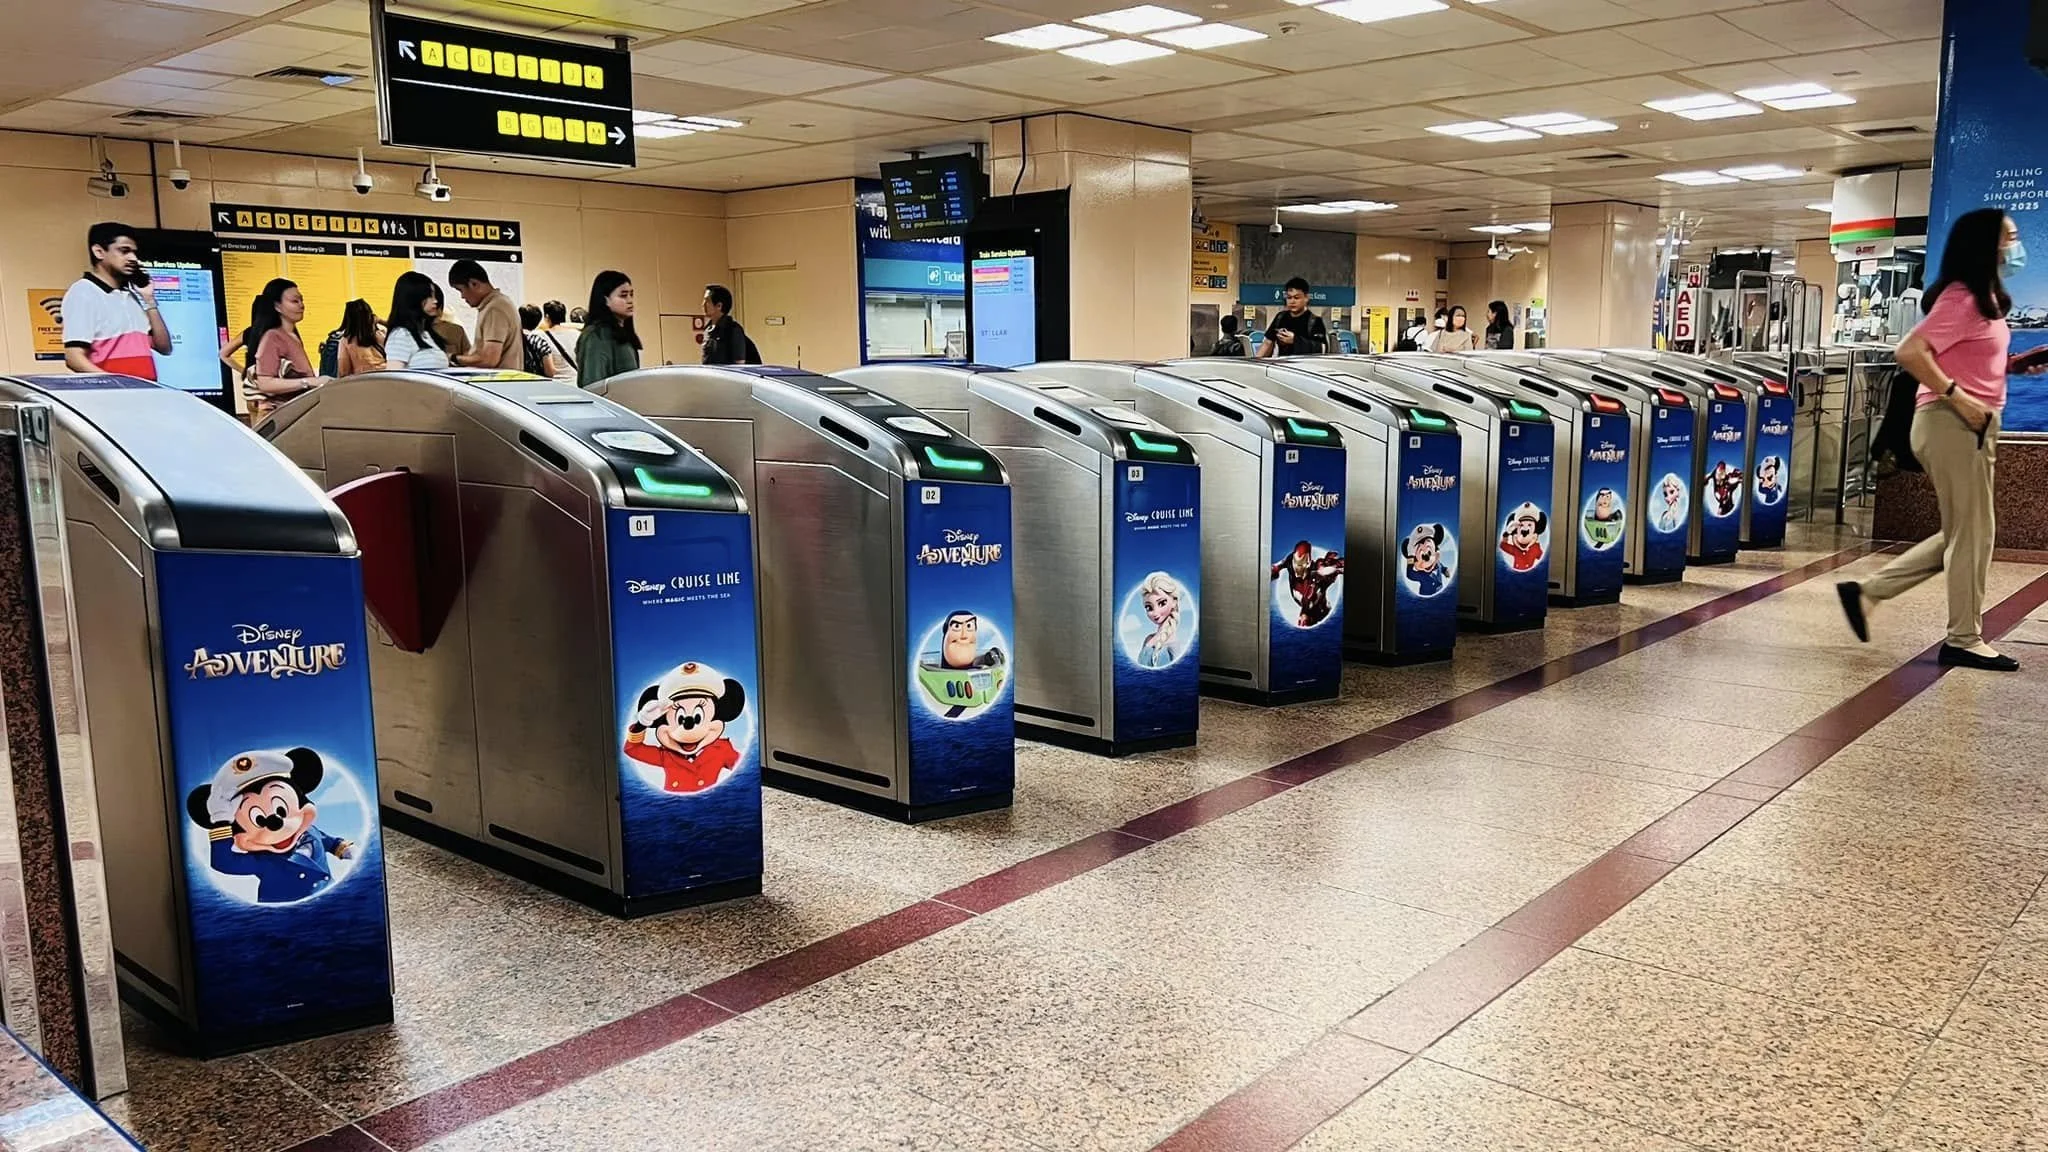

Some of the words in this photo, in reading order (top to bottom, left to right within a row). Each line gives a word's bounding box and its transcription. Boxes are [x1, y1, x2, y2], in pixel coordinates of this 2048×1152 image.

[1995, 167, 2043, 179] SAILING
[2001, 179, 2034, 189] FROM
[1983, 190, 2048, 202] SINGAPORE
[2010, 201, 2039, 211] 2025
[1676, 290, 1692, 337] AED
[1131, 469, 1140, 478] 03
[925, 490, 936, 500] 02
[1151, 508, 1176, 520] CRUISE
[1178, 507, 1194, 518] LINE
[635, 519, 649, 532] 01
[916, 543, 1002, 567] ADVENTURE
[670, 574, 711, 589] CRUISE
[716, 571, 740, 586] LINE
[183, 643, 347, 680] ADVENTURE
